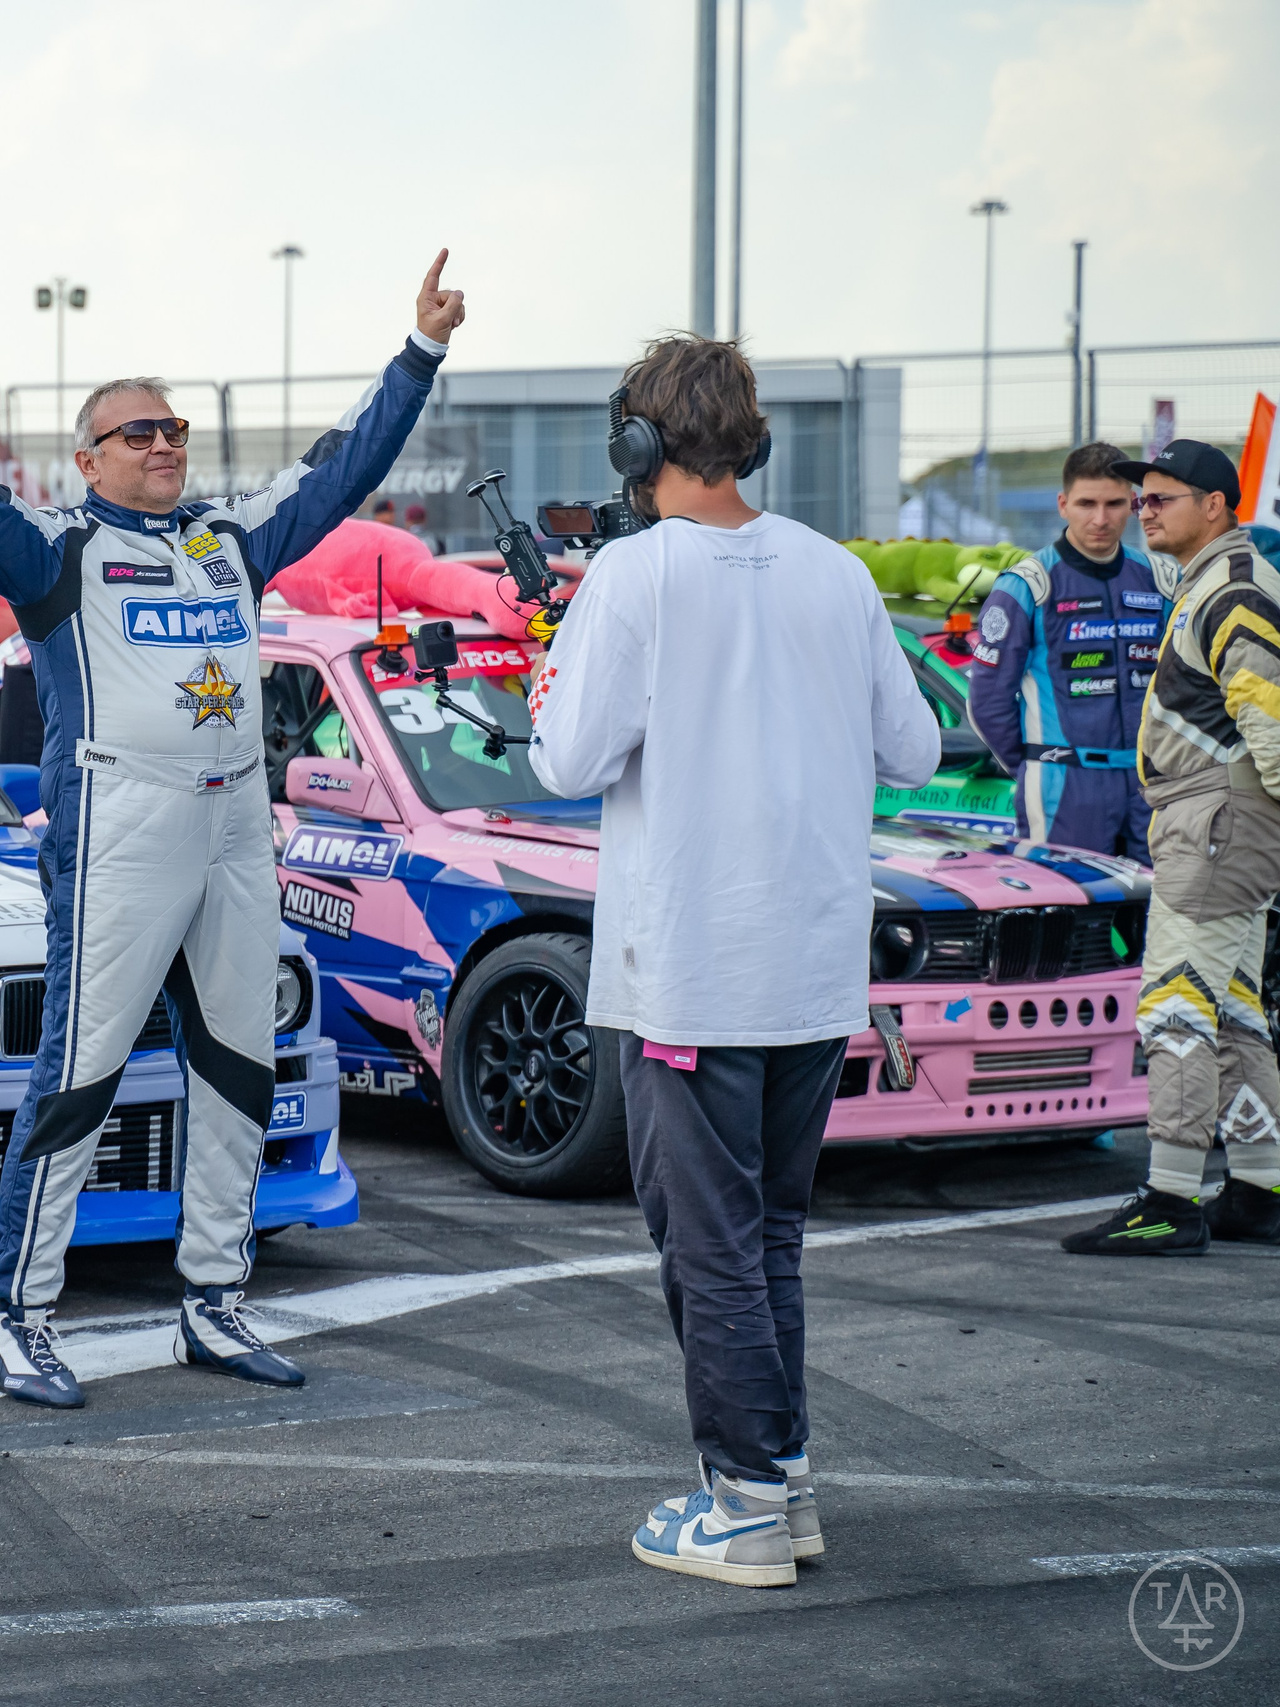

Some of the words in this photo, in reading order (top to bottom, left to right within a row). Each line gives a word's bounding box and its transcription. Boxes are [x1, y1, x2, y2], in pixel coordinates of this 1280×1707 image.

[143, 517, 170, 529] freem
[108, 567, 135, 578] RDS
[132, 605, 243, 637] AIMOL
[463, 649, 526, 668] RDS
[83, 748, 117, 766] freem
[287, 834, 390, 871] AIMOL
[284, 881, 354, 930] NOVUS
[283, 909, 313, 927] PREMIUM
[313, 919, 338, 935] MOTOR
[337, 928, 349, 939] OIL
